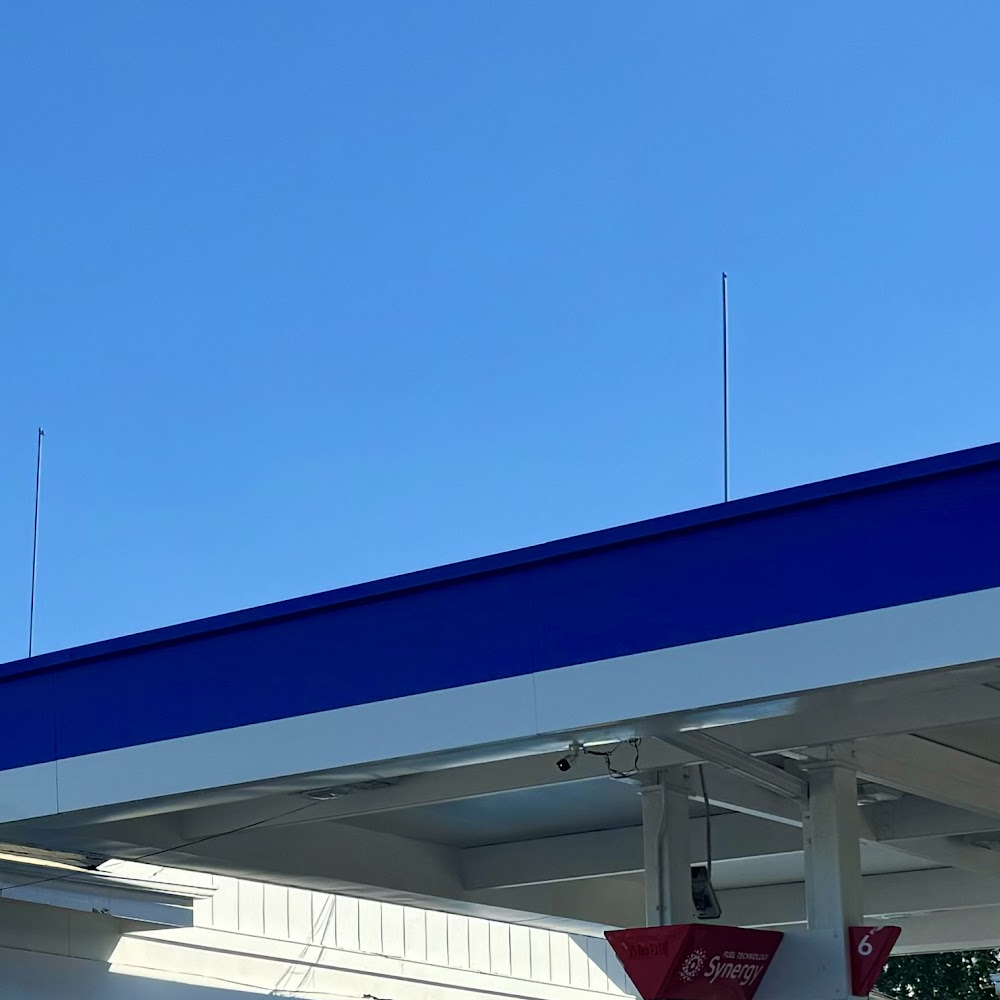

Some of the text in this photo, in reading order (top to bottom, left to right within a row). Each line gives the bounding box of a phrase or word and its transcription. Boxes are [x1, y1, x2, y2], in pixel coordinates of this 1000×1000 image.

[722, 951, 769, 961] FUEL TECHNOLOGY
[857, 934, 874, 956] 6
[703, 955, 764, 987] Synergy
